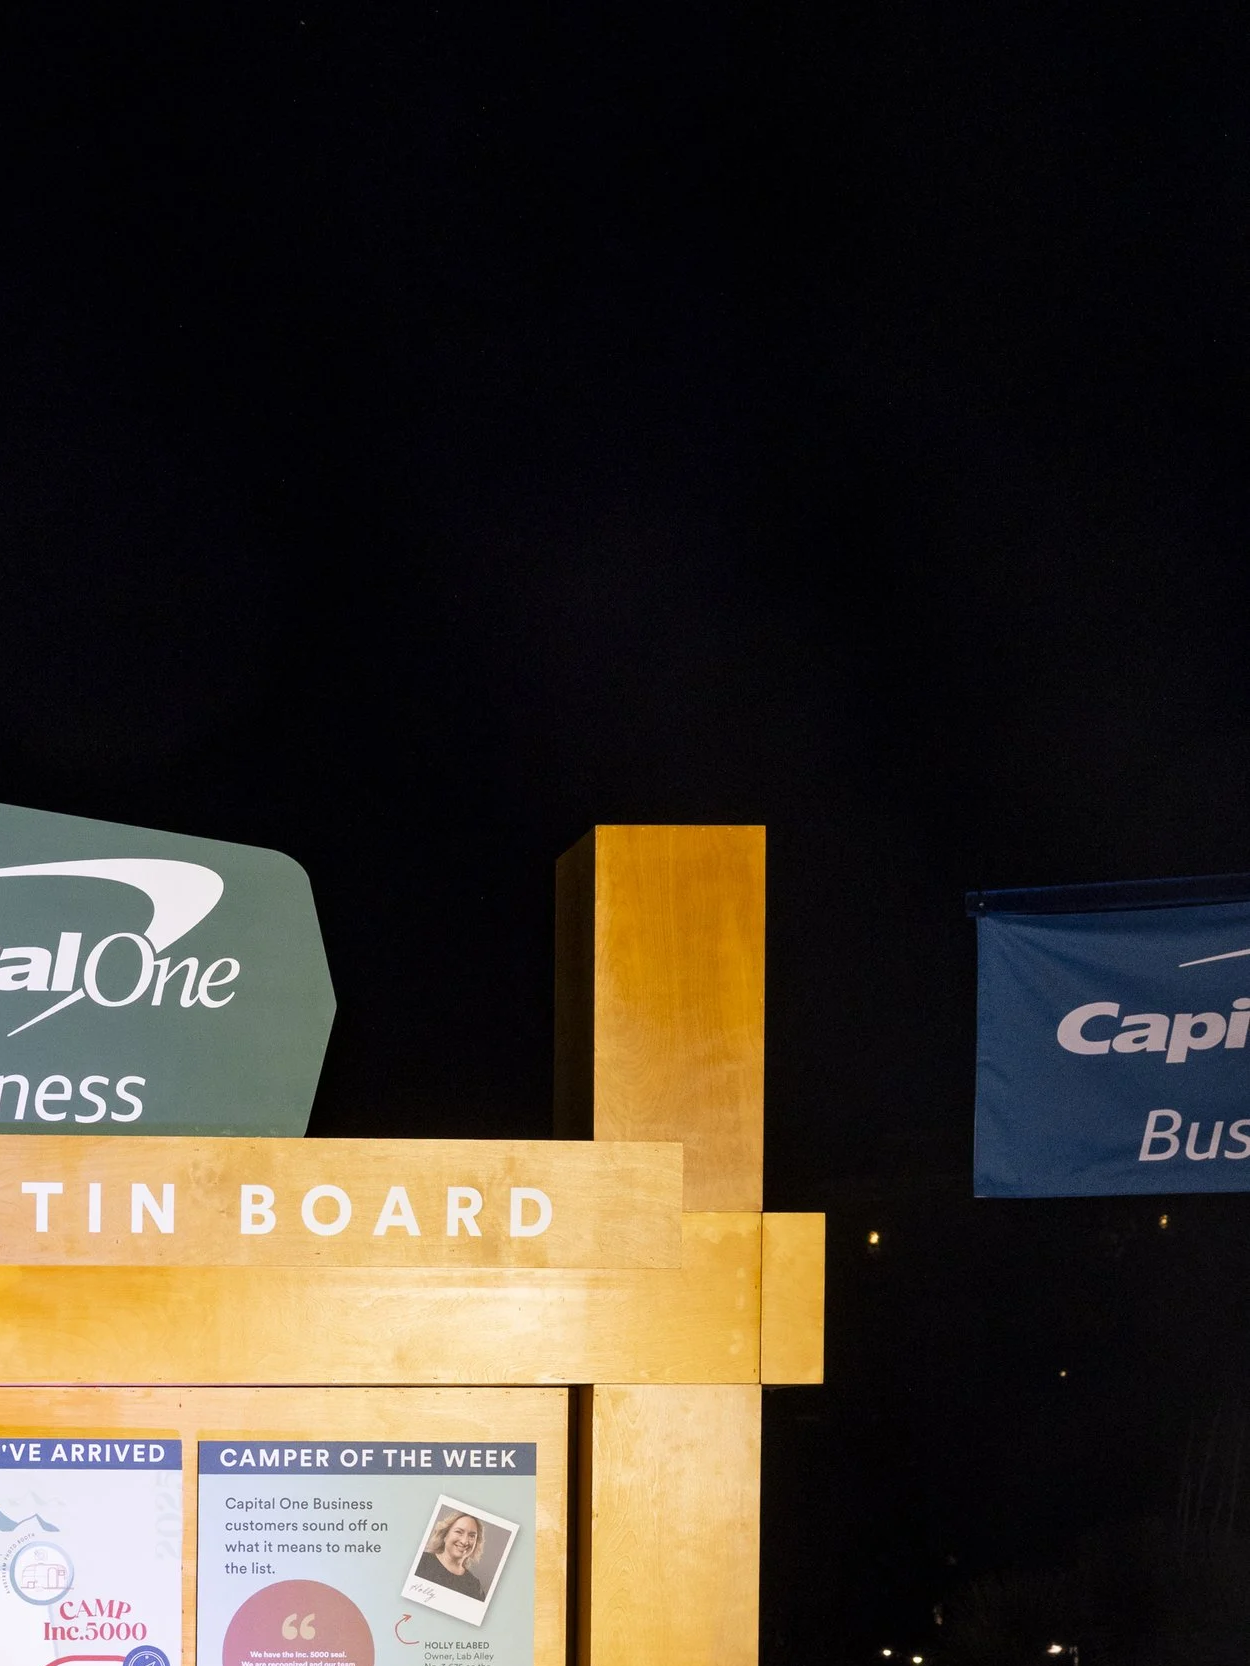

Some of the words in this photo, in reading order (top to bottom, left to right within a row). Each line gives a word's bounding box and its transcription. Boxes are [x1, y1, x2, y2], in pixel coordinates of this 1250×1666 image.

[241, 1185, 552, 1237] BOARD
[51, 1444, 165, 1462] ARRIVED
[220, 1448, 329, 1467] CAMPER
[340, 1449, 374, 1467] OF
[383, 1449, 432, 1467] THE
[443, 1449, 516, 1468] WEEK
[59, 1597, 131, 1620] CAMP
[456, 1641, 490, 1649] ELABED
[424, 1652, 455, 1661] Owner,
[456, 1652, 472, 1660] Lab
[473, 1652, 494, 1662] Alley
